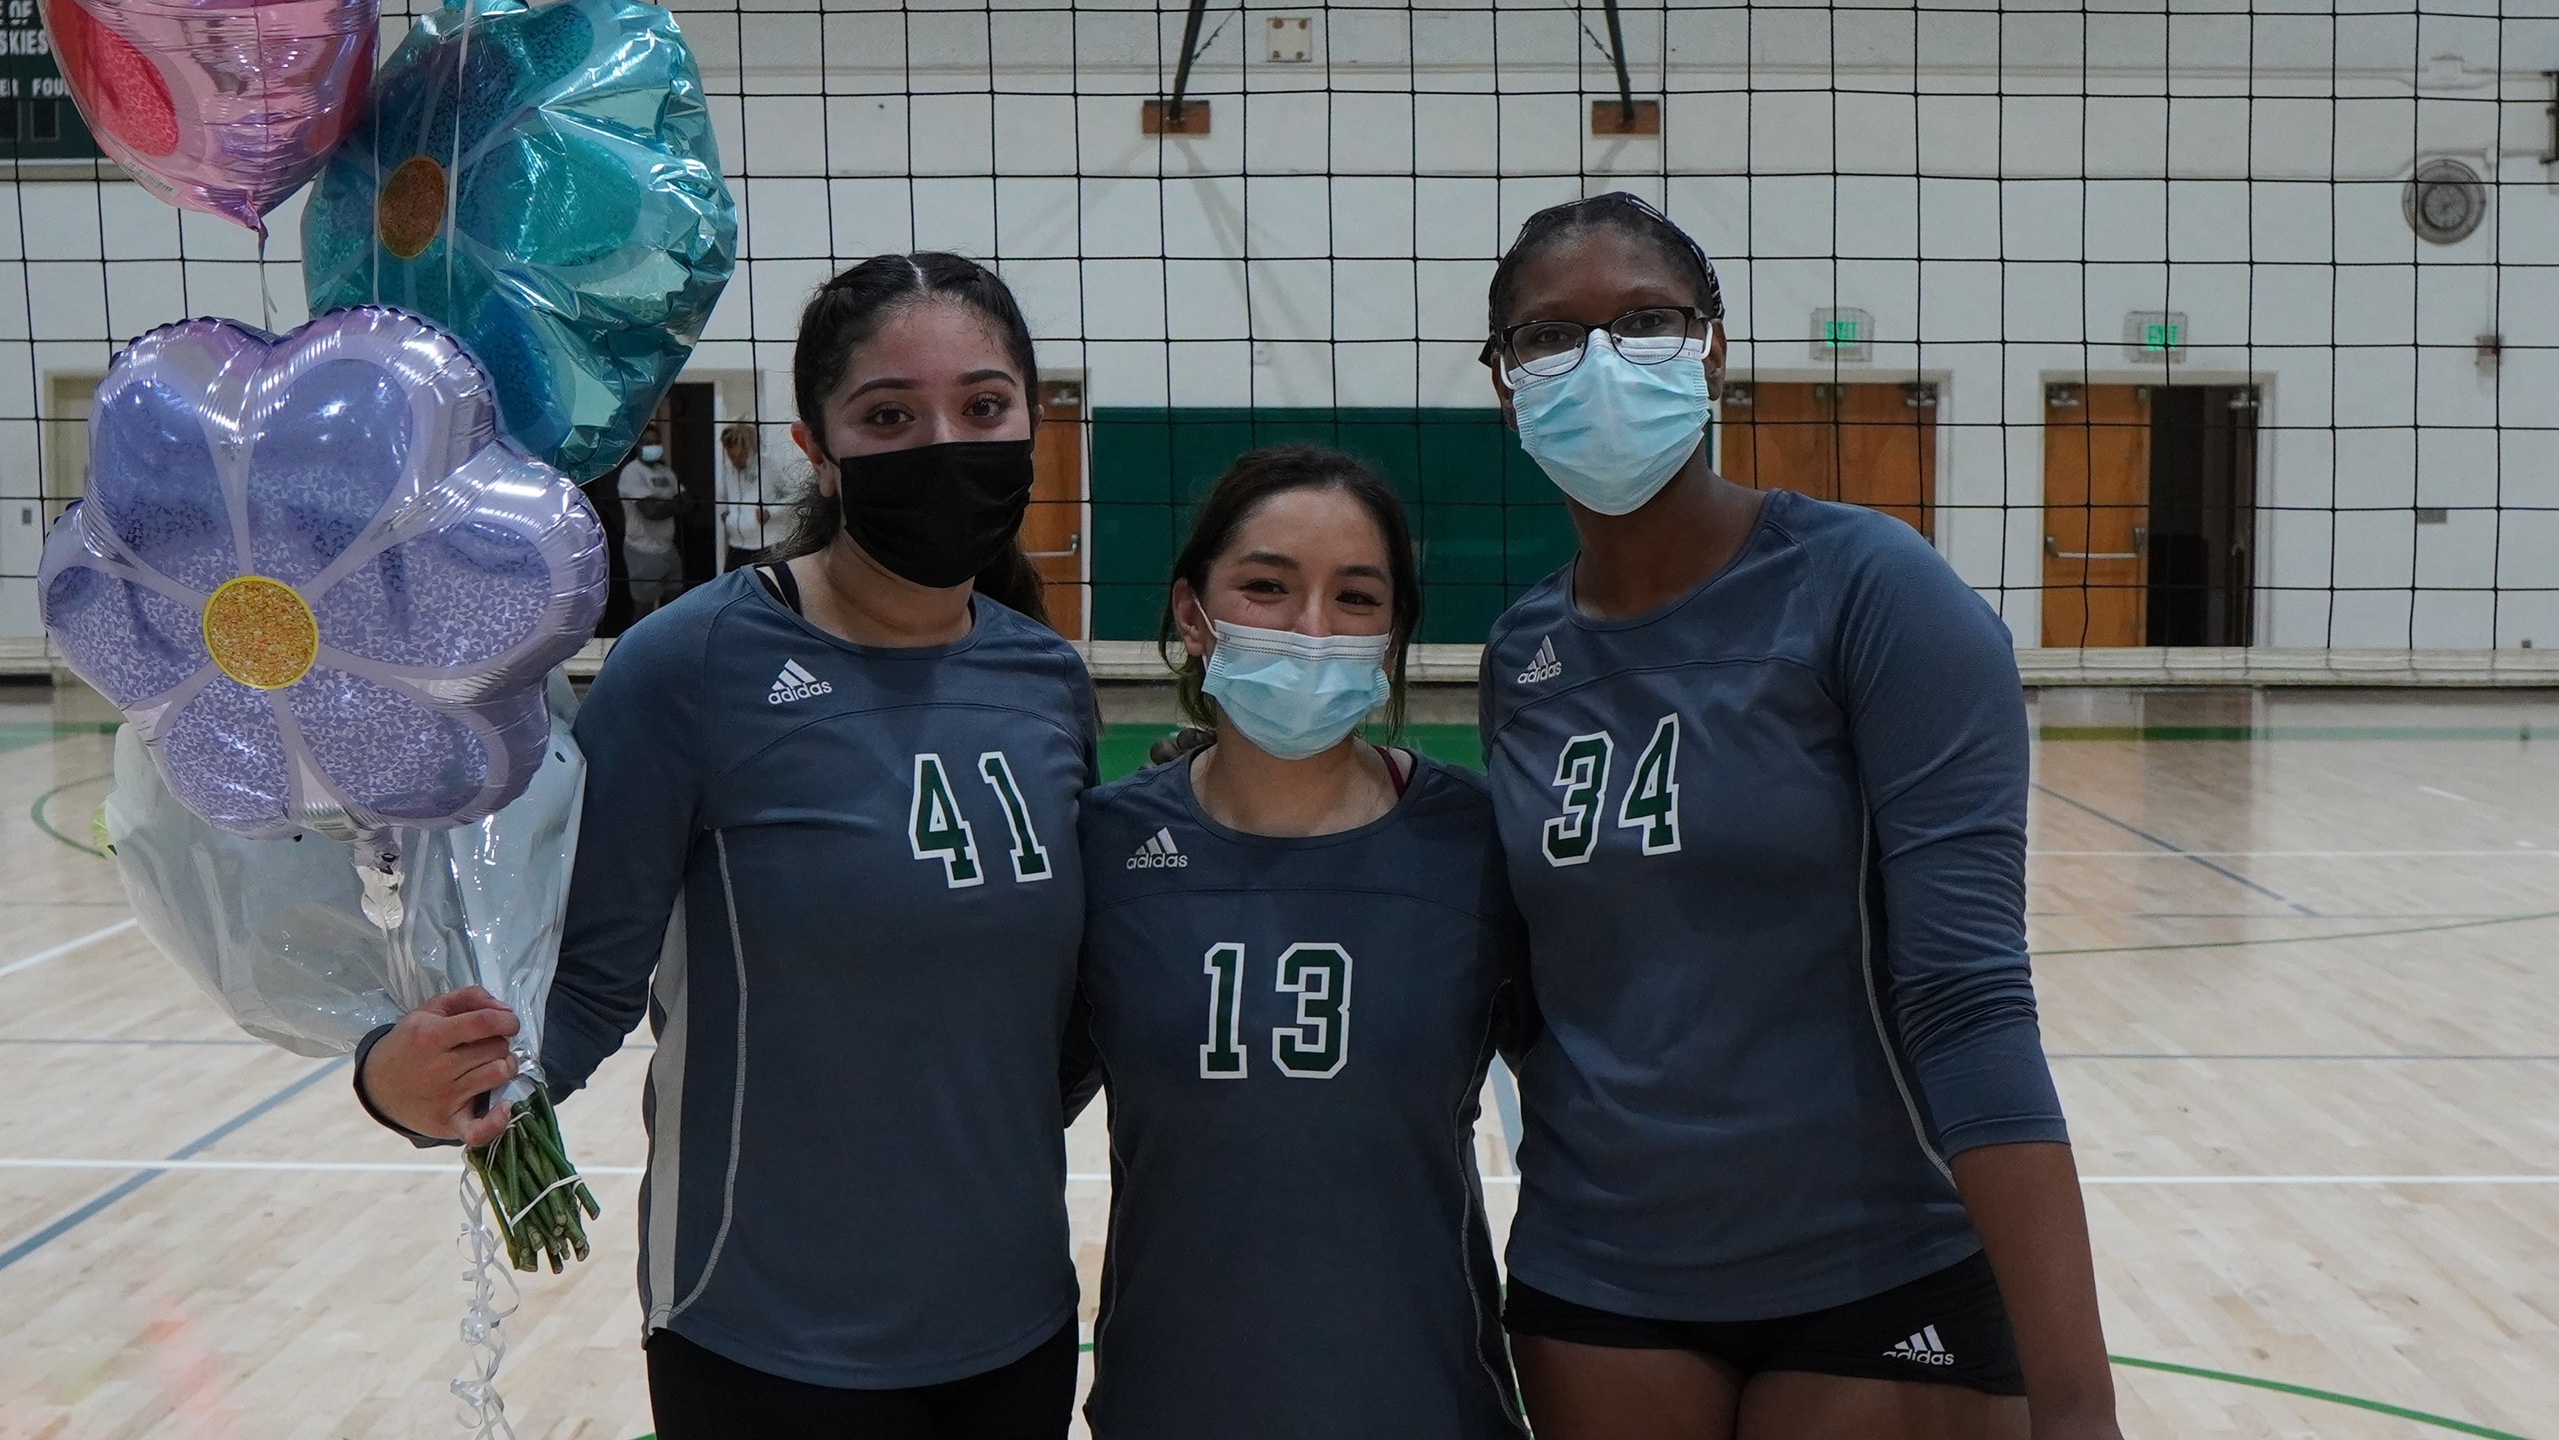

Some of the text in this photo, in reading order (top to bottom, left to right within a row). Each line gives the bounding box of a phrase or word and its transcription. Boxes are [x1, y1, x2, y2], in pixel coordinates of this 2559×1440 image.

[768, 681, 833, 705] adidas
[1517, 661, 1562, 684] adidas
[908, 751, 1052, 888] 41
[1542, 712, 1681, 867] 34
[1126, 852, 1188, 870] adidas
[1200, 942, 1353, 1079] 13
